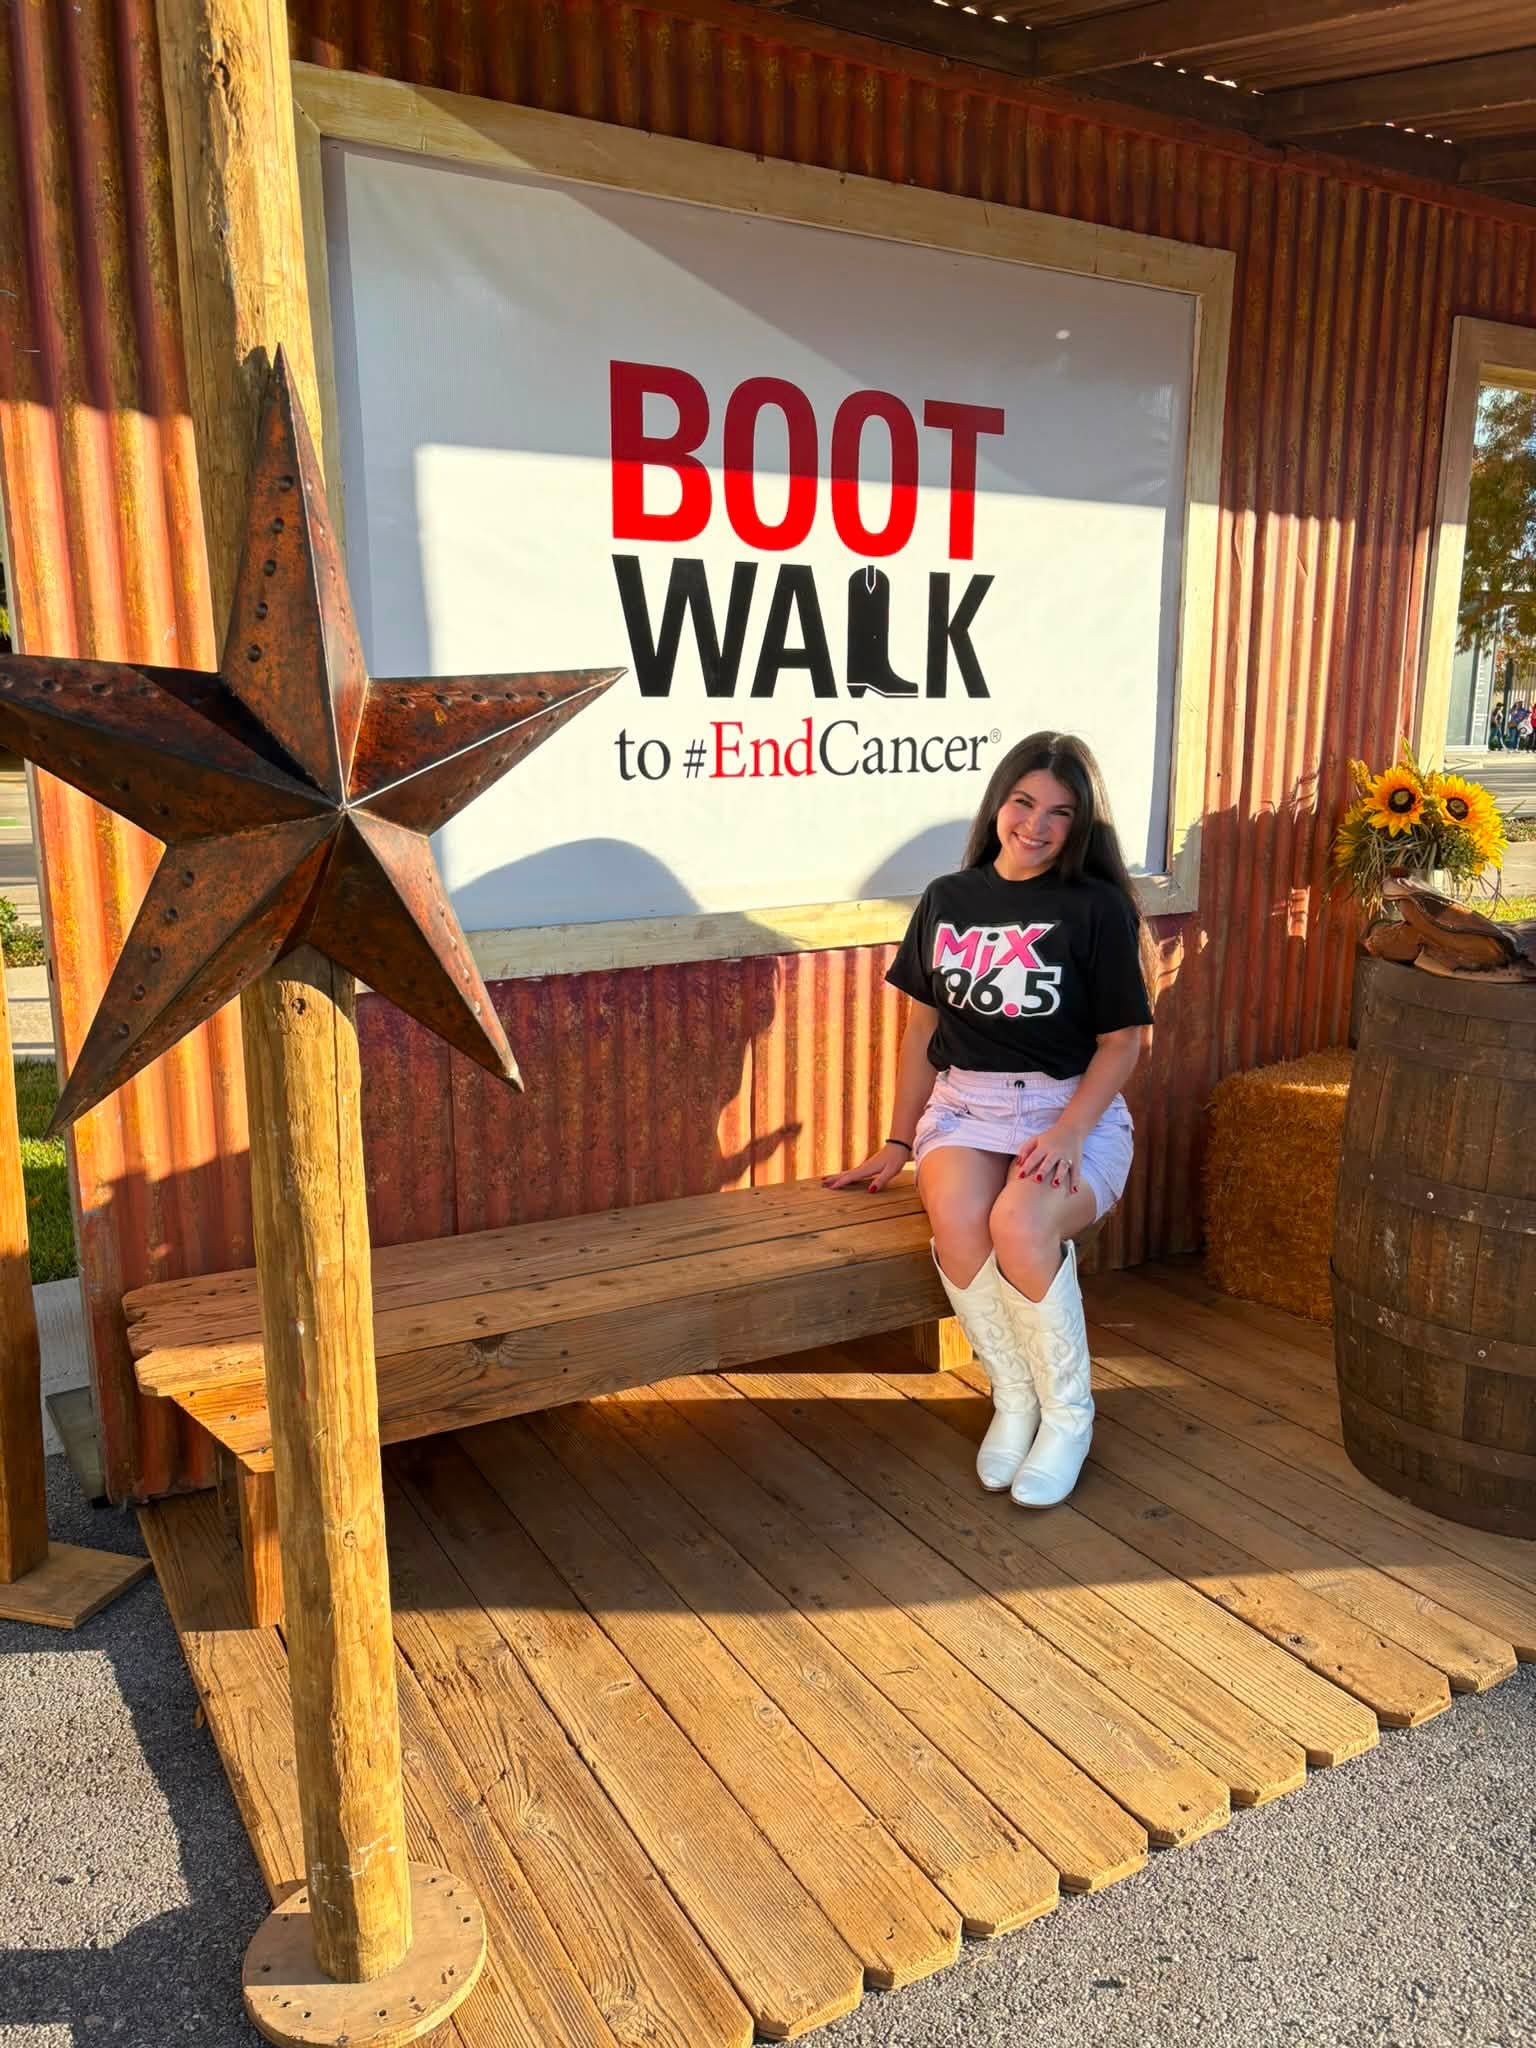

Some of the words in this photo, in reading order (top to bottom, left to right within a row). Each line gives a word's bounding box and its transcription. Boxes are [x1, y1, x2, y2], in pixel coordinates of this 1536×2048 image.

[610, 360, 1005, 560] BOOT
[612, 553, 996, 699] WALK
[615, 728, 671, 781] to
[935, 966, 1060, 1016] 96.5
